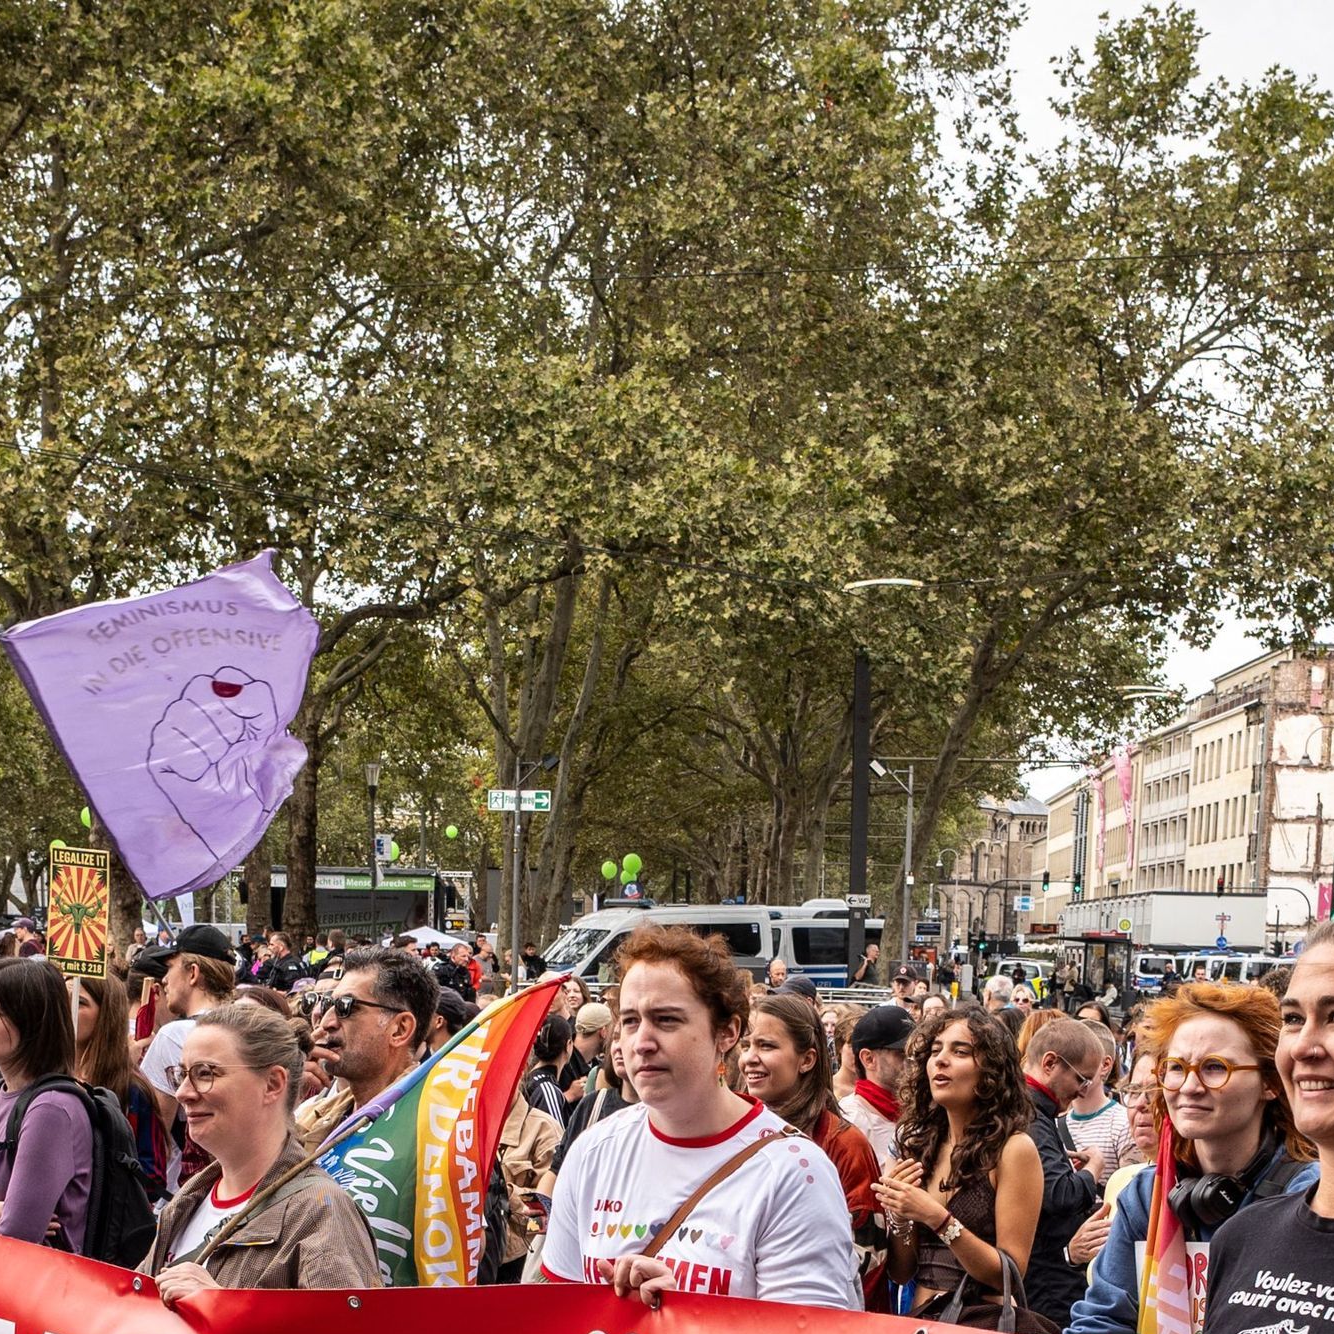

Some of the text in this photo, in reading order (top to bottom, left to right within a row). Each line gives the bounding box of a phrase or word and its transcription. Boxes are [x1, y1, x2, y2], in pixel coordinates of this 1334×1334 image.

[88, 600, 239, 645] FEMINISMUS
[83, 626, 283, 696] IN DIE OFFENSIVE
[53, 850, 106, 867] LEGALIZE IT
[67, 960, 81, 972] mit
[87, 963, 103, 974] 218
[593, 1199, 624, 1213] JKO
[1227, 1290, 1276, 1306] courir
[1275, 1297, 1325, 1318] avec
